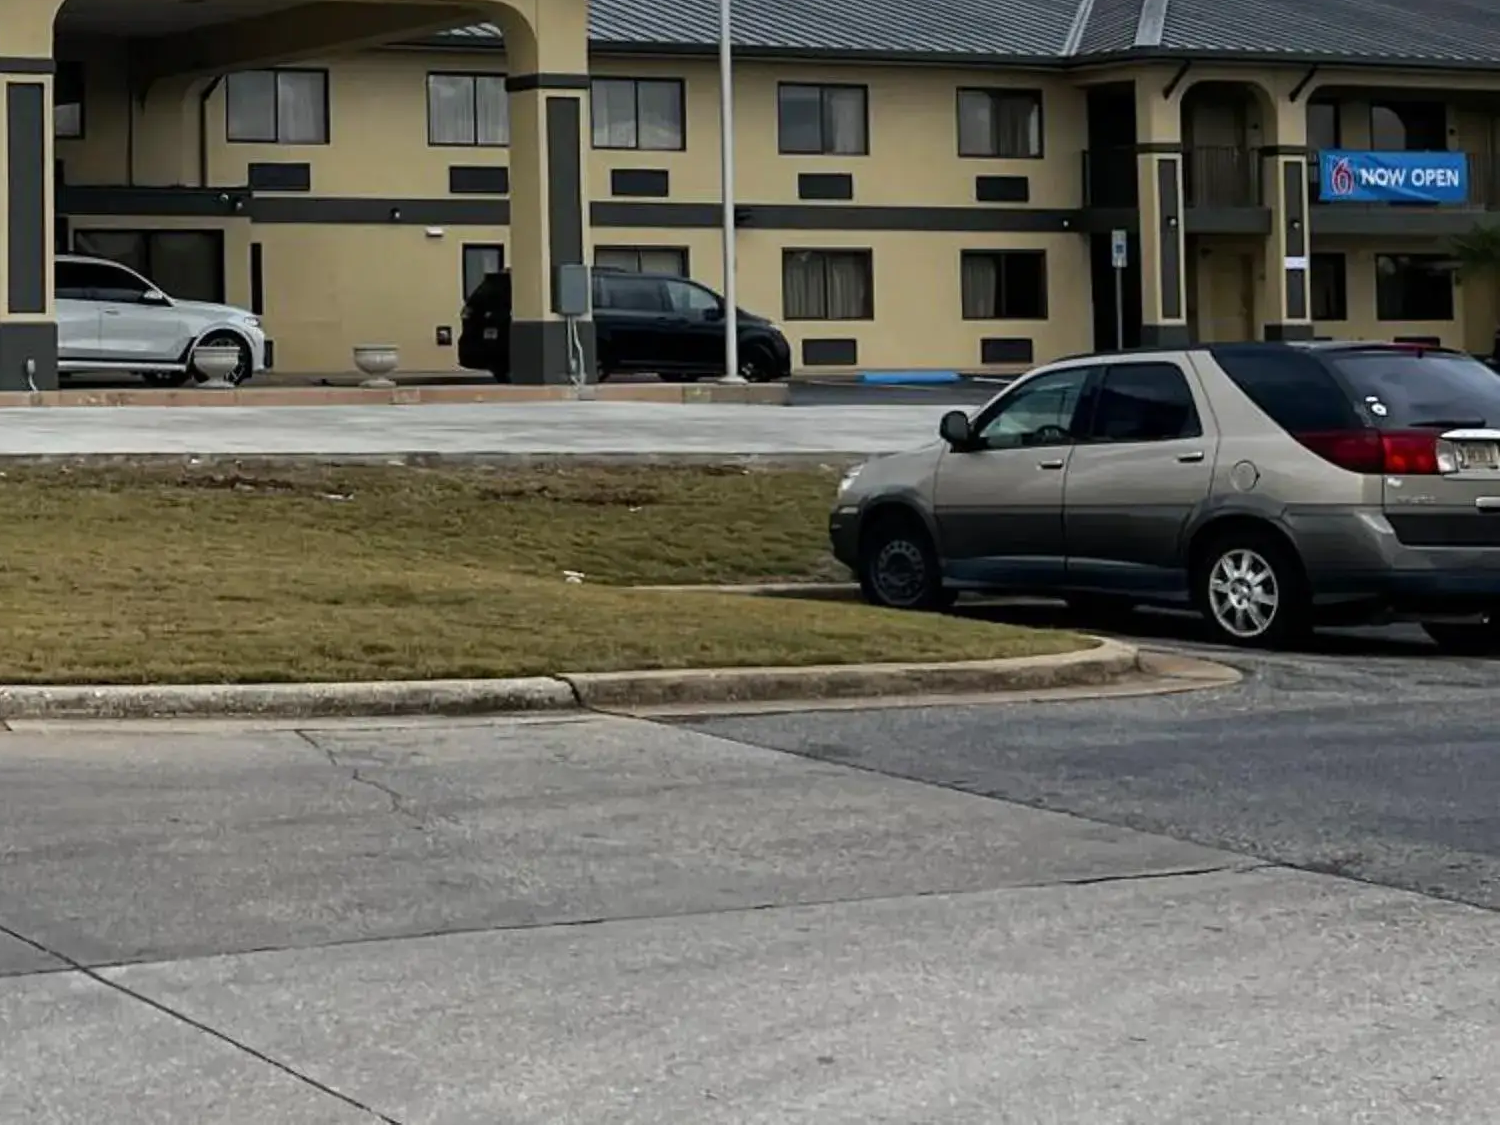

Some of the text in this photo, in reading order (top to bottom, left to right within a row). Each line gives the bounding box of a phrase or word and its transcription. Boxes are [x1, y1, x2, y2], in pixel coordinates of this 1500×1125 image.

[1332, 156, 1460, 195] 6 NOW OPEN
